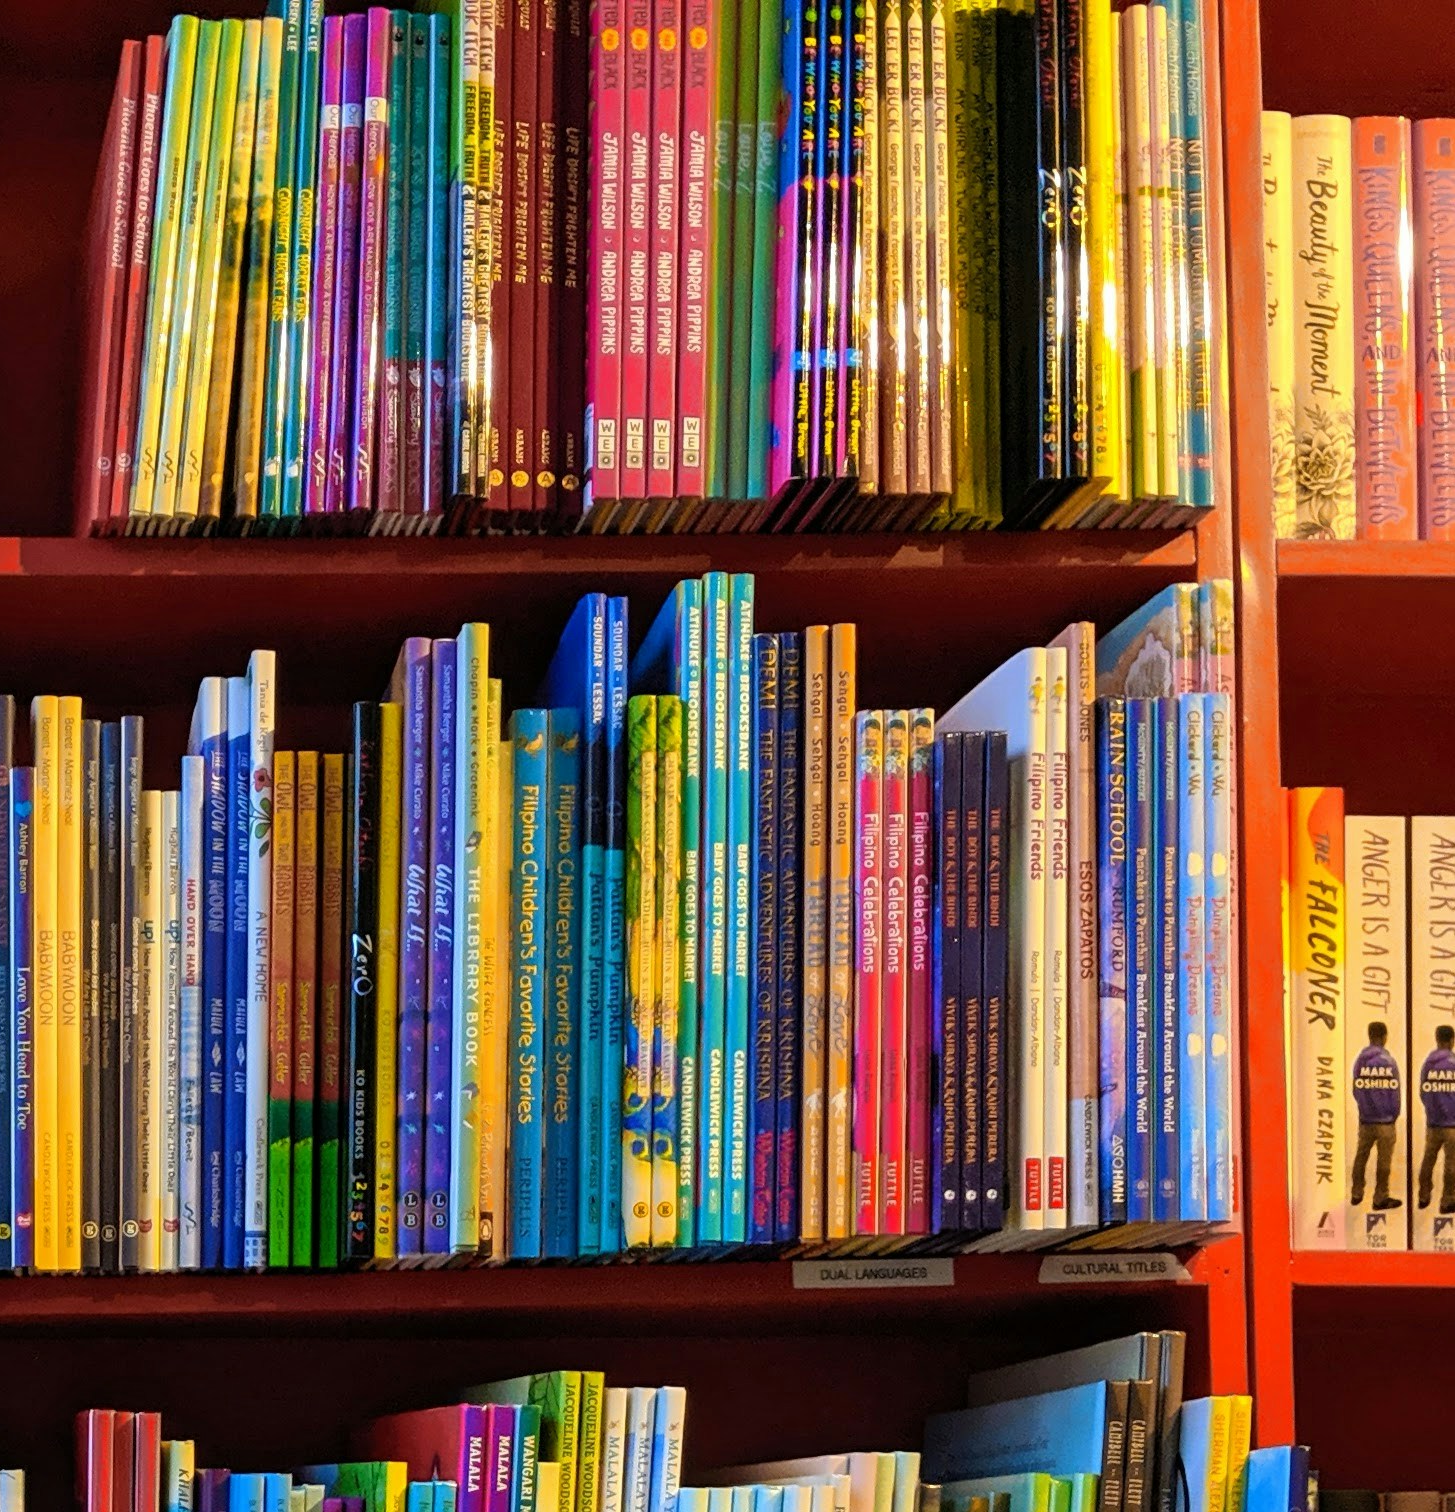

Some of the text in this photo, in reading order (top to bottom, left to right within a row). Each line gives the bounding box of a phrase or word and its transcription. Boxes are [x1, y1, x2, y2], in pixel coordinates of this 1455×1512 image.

[133, 93, 158, 264] Phoenix Goes to School
[460, 86, 476, 382] FREEDOM, TRUTH & HARLEM'S GREATEST BOOKSTORE
[1298, 156, 1341, 400] The Beauty of the Moment
[1050, 752, 1068, 880] Filipino Friends
[1108, 711, 1127, 867] RAIN SCHOOL
[910, 811, 929, 971] Filipino Celebrations
[1077, 860, 1095, 980] ESOS ZAPATOS
[1305, 832, 1337, 1030] THE FALCONER
[1361, 829, 1389, 1012] ANGER IS A GIFT
[60, 930, 78, 1026] BABYMOON
[463, 866, 483, 1067] THE LIBRARY BOOK
[1161, 846, 1177, 1133] Pancakes to Parathas: Breakfast Around the World
[15, 966, 32, 1130] Love You Head to Toe
[1355, 1078, 1398, 1089] OSHIRO
[1360, 1067, 1393, 1077] MARK
[912, 1158, 925, 1204] TUTTLE
[1315, 1056, 1335, 1185] DANA CZAPNIK
[820, 1268, 927, 1280] DUAL LANGUAGES
[1062, 1262, 1166, 1275] CULTURAL TITLES
[517, 1435, 535, 1501] WANGARI
[604, 1436, 621, 1496] MALALA
